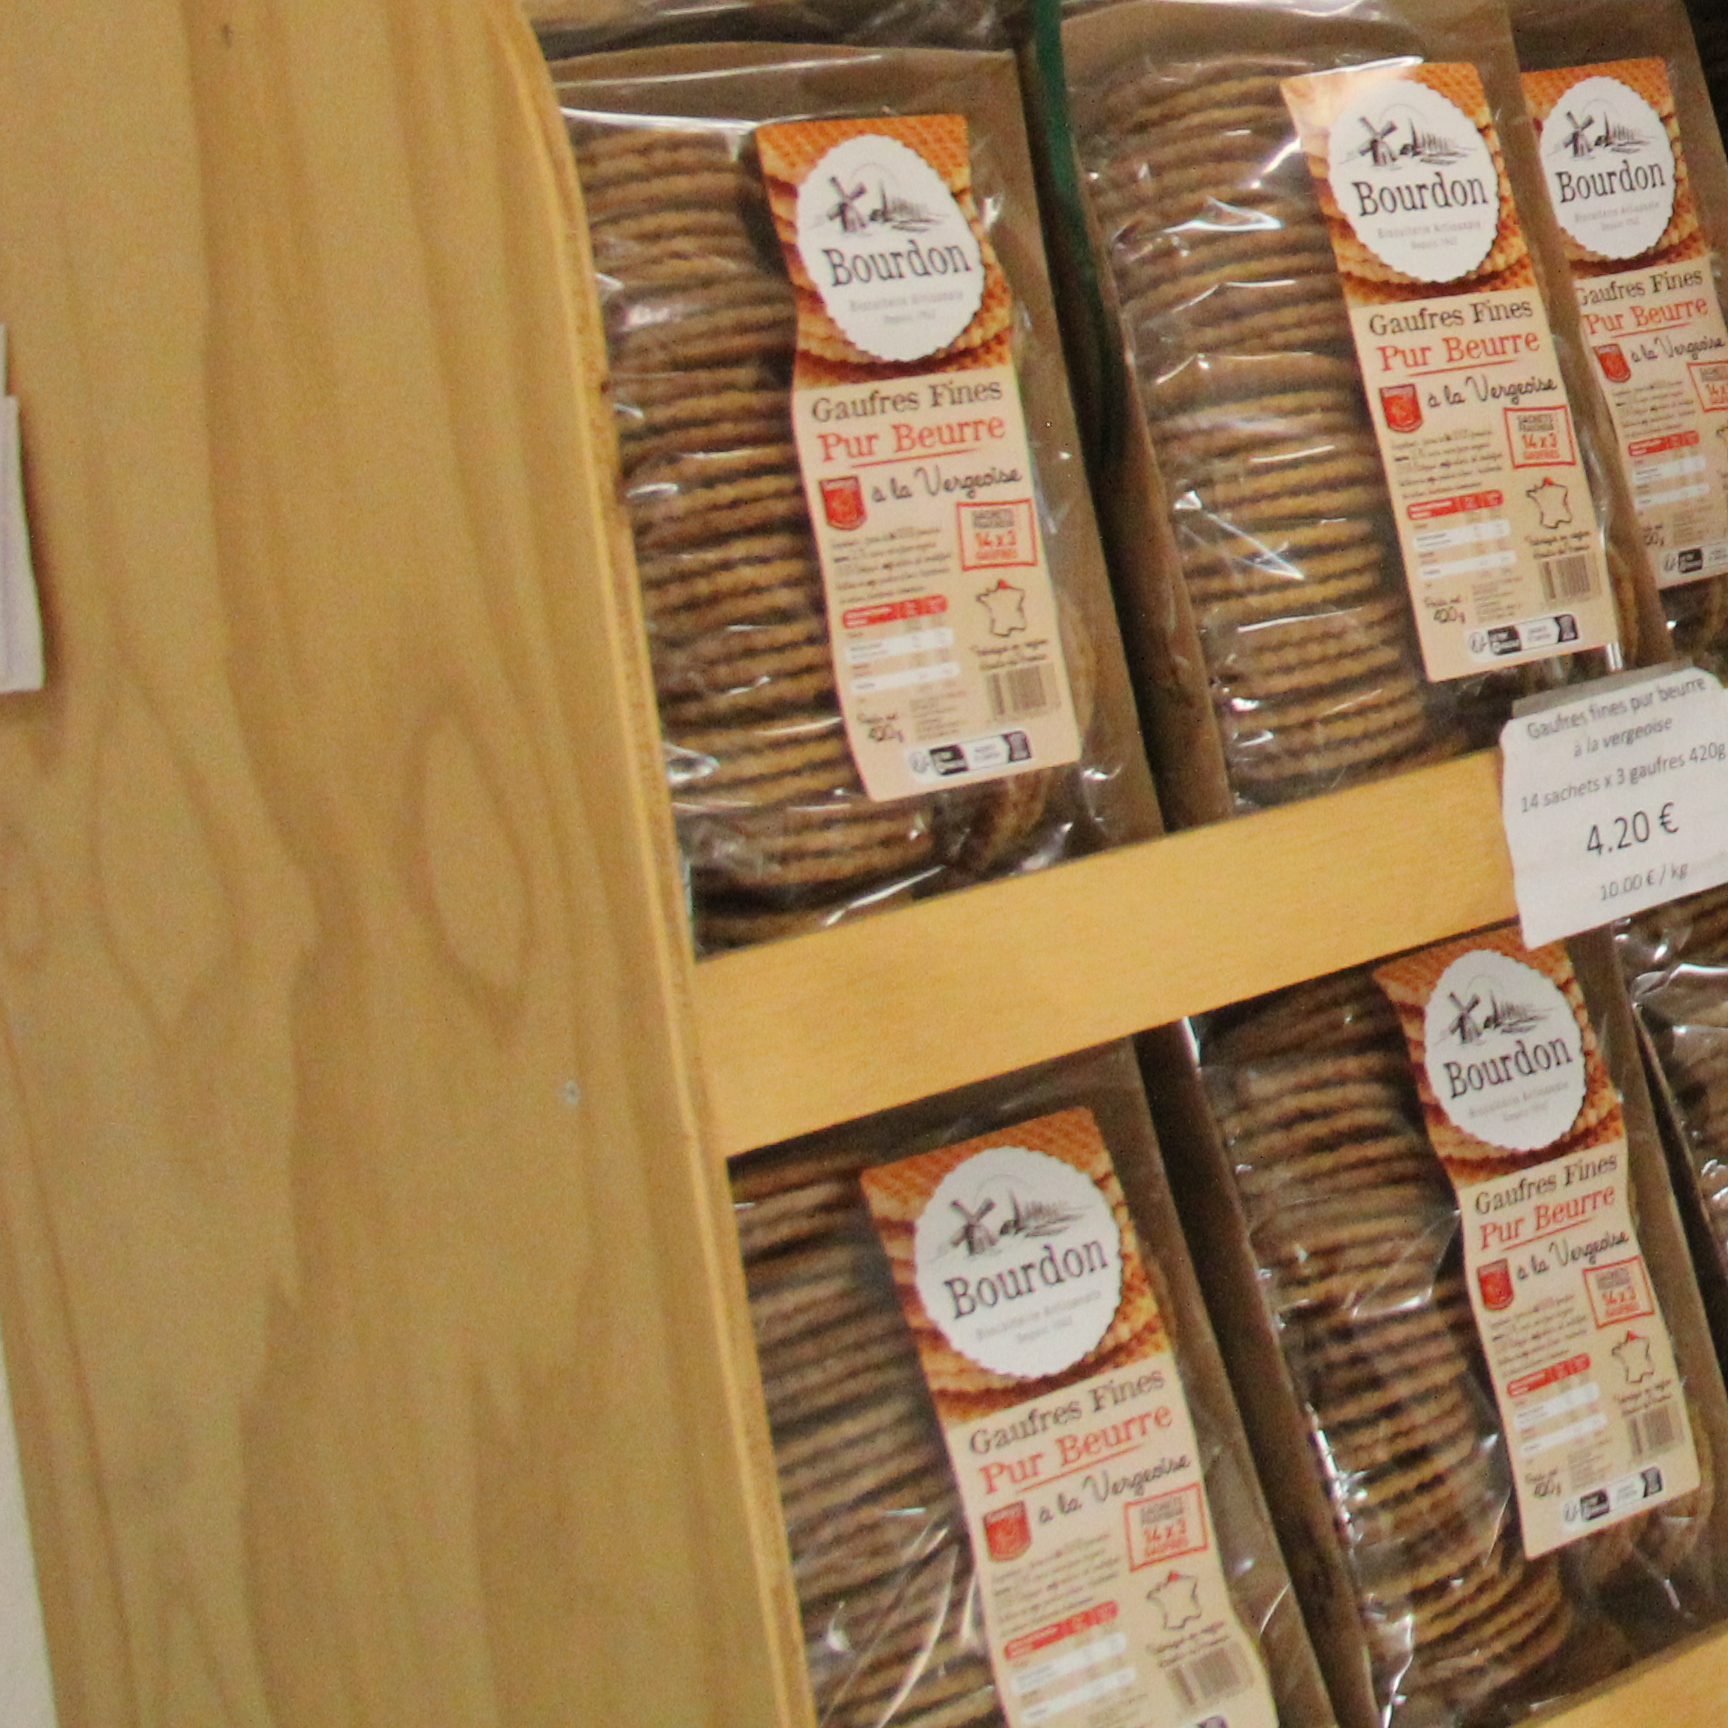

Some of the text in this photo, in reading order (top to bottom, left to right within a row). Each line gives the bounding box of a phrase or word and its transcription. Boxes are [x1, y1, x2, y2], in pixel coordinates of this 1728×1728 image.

[1352, 172, 1488, 217] Bourdon
[1555, 159, 1666, 203] Bourdon
[821, 239, 972, 287] Bourdon
[1649, 271, 1702, 294] Fines
[1369, 299, 1533, 336] Gaufres Fines
[1582, 298, 1709, 335] Pur Beurre
[1377, 332, 1540, 372] Pur Beurre
[812, 379, 1002, 422] Gaufres Fines
[1444, 385, 1465, 405] la
[1465, 374, 1557, 405] Vergeoise
[817, 415, 1006, 462] Pur Beurre
[1527, 677, 1706, 739] Gaufres fines pur beurre
[1586, 739, 1599, 753] la
[1603, 717, 1672, 748] vergeoise
[1521, 742, 1726, 813] 14 sachets x 3 gaufres 420g
[1586, 801, 1679, 855] 4.20 €
[1671, 863, 1689, 880] kg
[1443, 1037, 1574, 1098] Bourdon
[1475, 1155, 1618, 1215] Gaufres Fines
[1479, 1185, 1616, 1250] Pur Beurre
[944, 1239, 1109, 1319] Bourdon
[970, 1369, 1166, 1456] Gaufres Fines
[978, 1405, 1173, 1495] Pur Beurre
